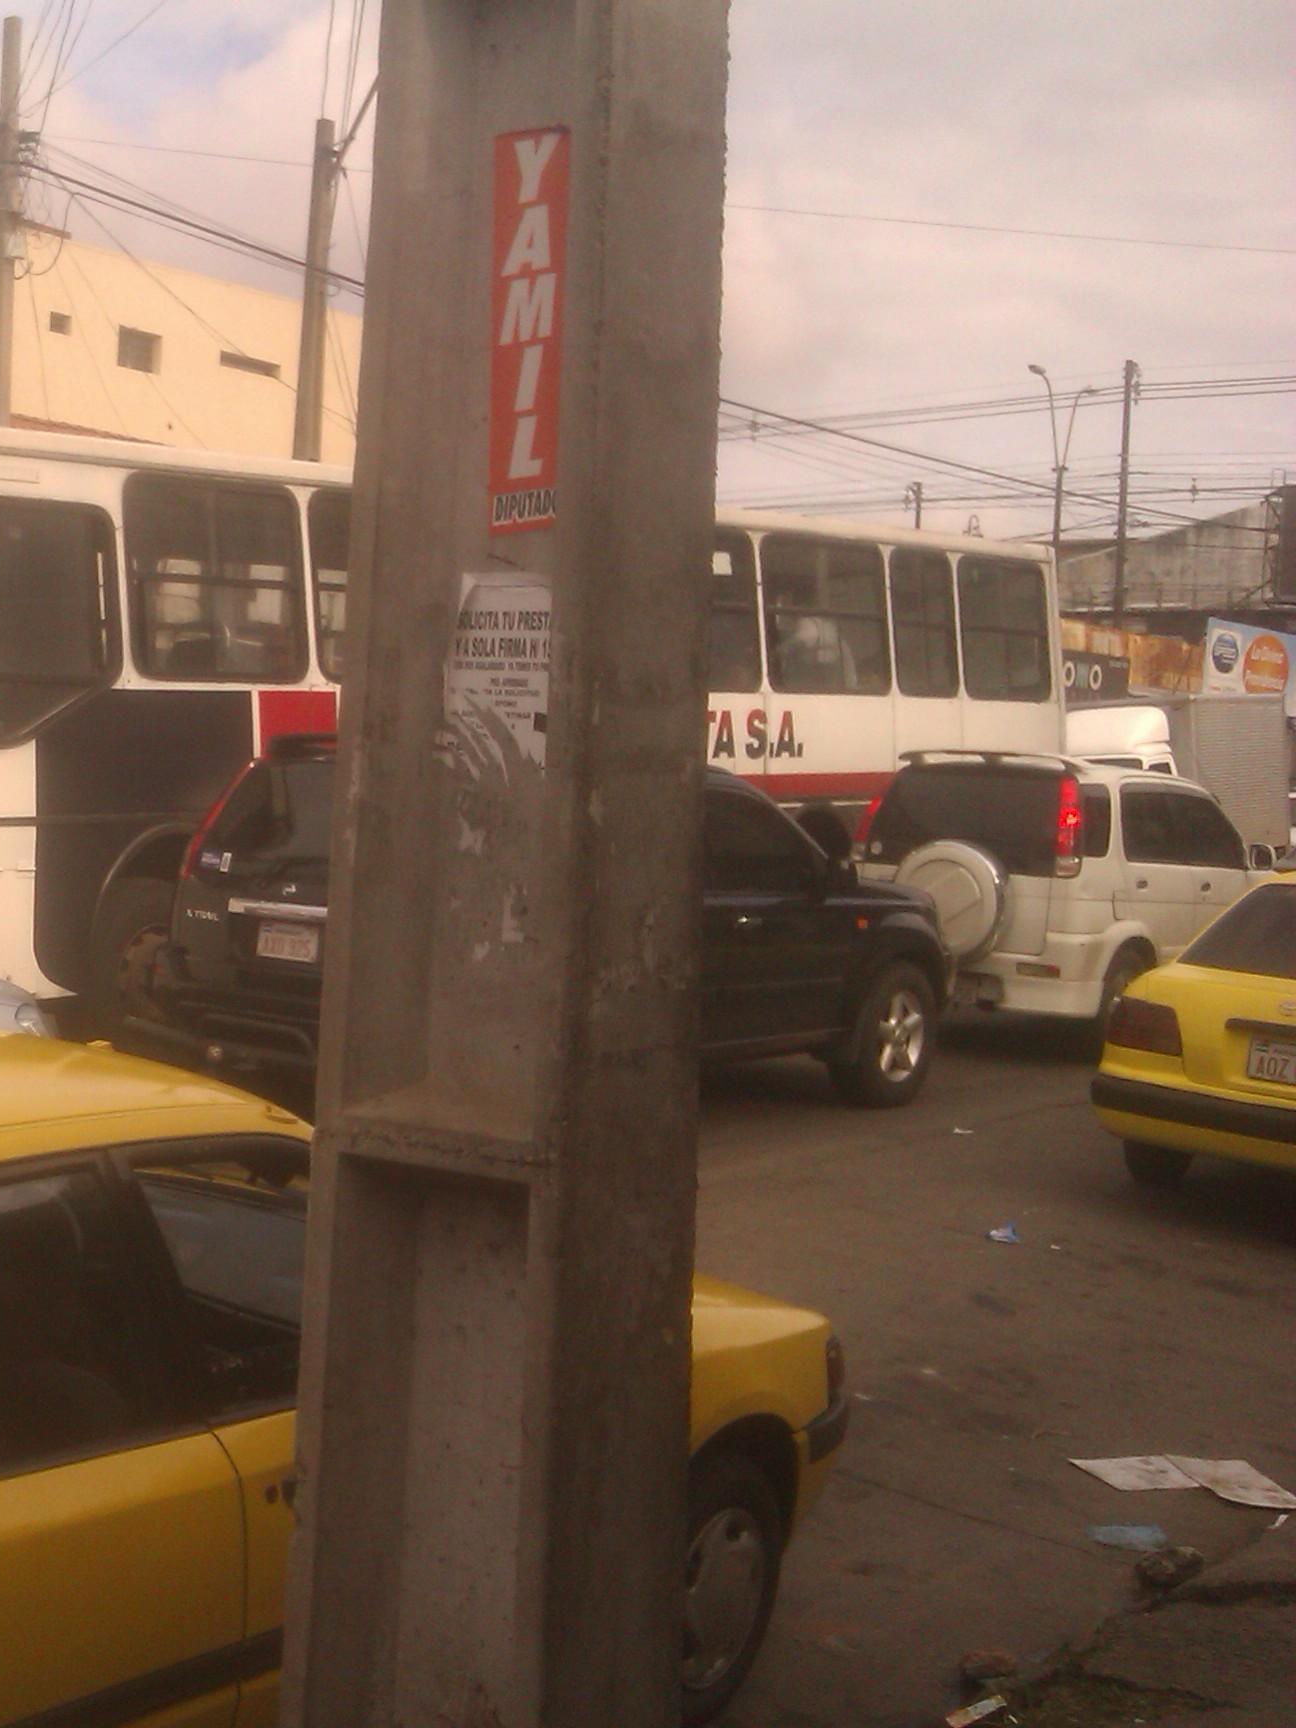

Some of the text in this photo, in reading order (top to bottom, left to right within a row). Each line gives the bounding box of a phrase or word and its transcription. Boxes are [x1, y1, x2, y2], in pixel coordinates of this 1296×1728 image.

[499, 132, 562, 480] YAMIL
[501, 610, 517, 631] TU
[516, 610, 550, 631] PREST
[470, 637, 497, 657] SOLA
[745, 708, 803, 759] S.A.
